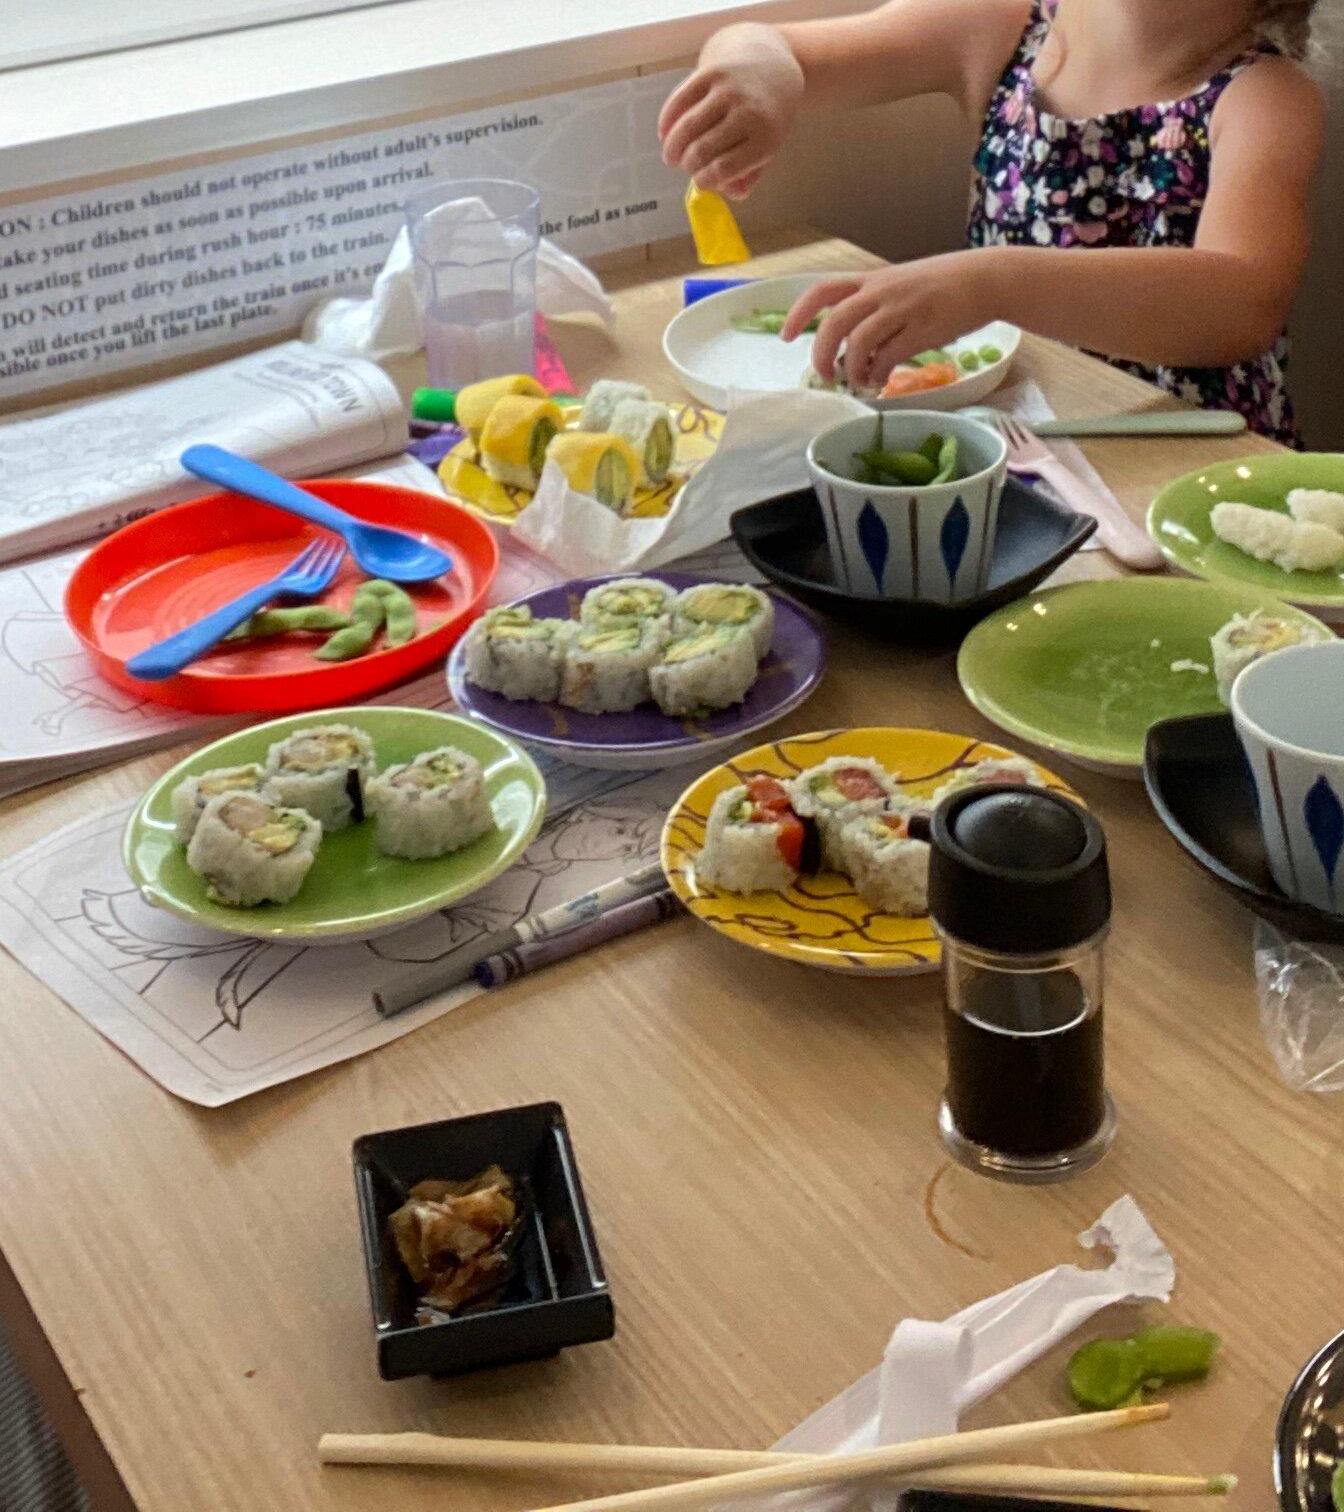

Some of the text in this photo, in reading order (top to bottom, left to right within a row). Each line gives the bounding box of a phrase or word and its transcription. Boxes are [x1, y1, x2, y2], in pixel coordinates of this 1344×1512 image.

[42, 238, 86, 265] your
[91, 225, 149, 249] dishes
[154, 221, 173, 235] as
[179, 211, 219, 229] soon
[225, 205, 244, 219] as
[249, 187, 319, 220] possible
[323, 178, 368, 202] upon
[372, 162, 434, 188] arrival.
[51, 198, 135, 227] Children
[141, 180, 202, 208] should
[207, 176, 237, 195] not
[241, 162, 308, 189] operate
[312, 146, 379, 170] without
[384, 131, 441, 158] adult's
[446, 112, 543, 145] supervision.
[15, 270, 82, 296] seating
[87, 261, 129, 280] time
[134, 245, 197, 270] during
[201, 232, 242, 254] rush
[247, 223, 290, 245] hour
[306, 212, 327, 231] 75
[537, 199, 658, 236] the food as soon
[2, 307, 35, 329] DO
[42, 294, 89, 320] NOT
[94, 289, 126, 313] put
[131, 279, 176, 300] dirty
[182, 264, 237, 288] dishes
[243, 251, 286, 275] back
[289, 249, 307, 264] to
[312, 241, 338, 259] the
[343, 230, 388, 252] train.
[13, 337, 46, 358] will
[51, 326, 105, 349] detect
[112, 315, 145, 335] and
[152, 303, 207, 326] return
[213, 294, 239, 312] the
[244, 284, 287, 304] train
[291, 274, 329, 293] once
[335, 266, 359, 283] it's
[46, 347, 89, 367] once
[93, 338, 125, 361] you
[131, 328, 156, 347] lift
[163, 321, 189, 340] the
[195, 314, 225, 332] last
[231, 304, 277, 327] plate.
